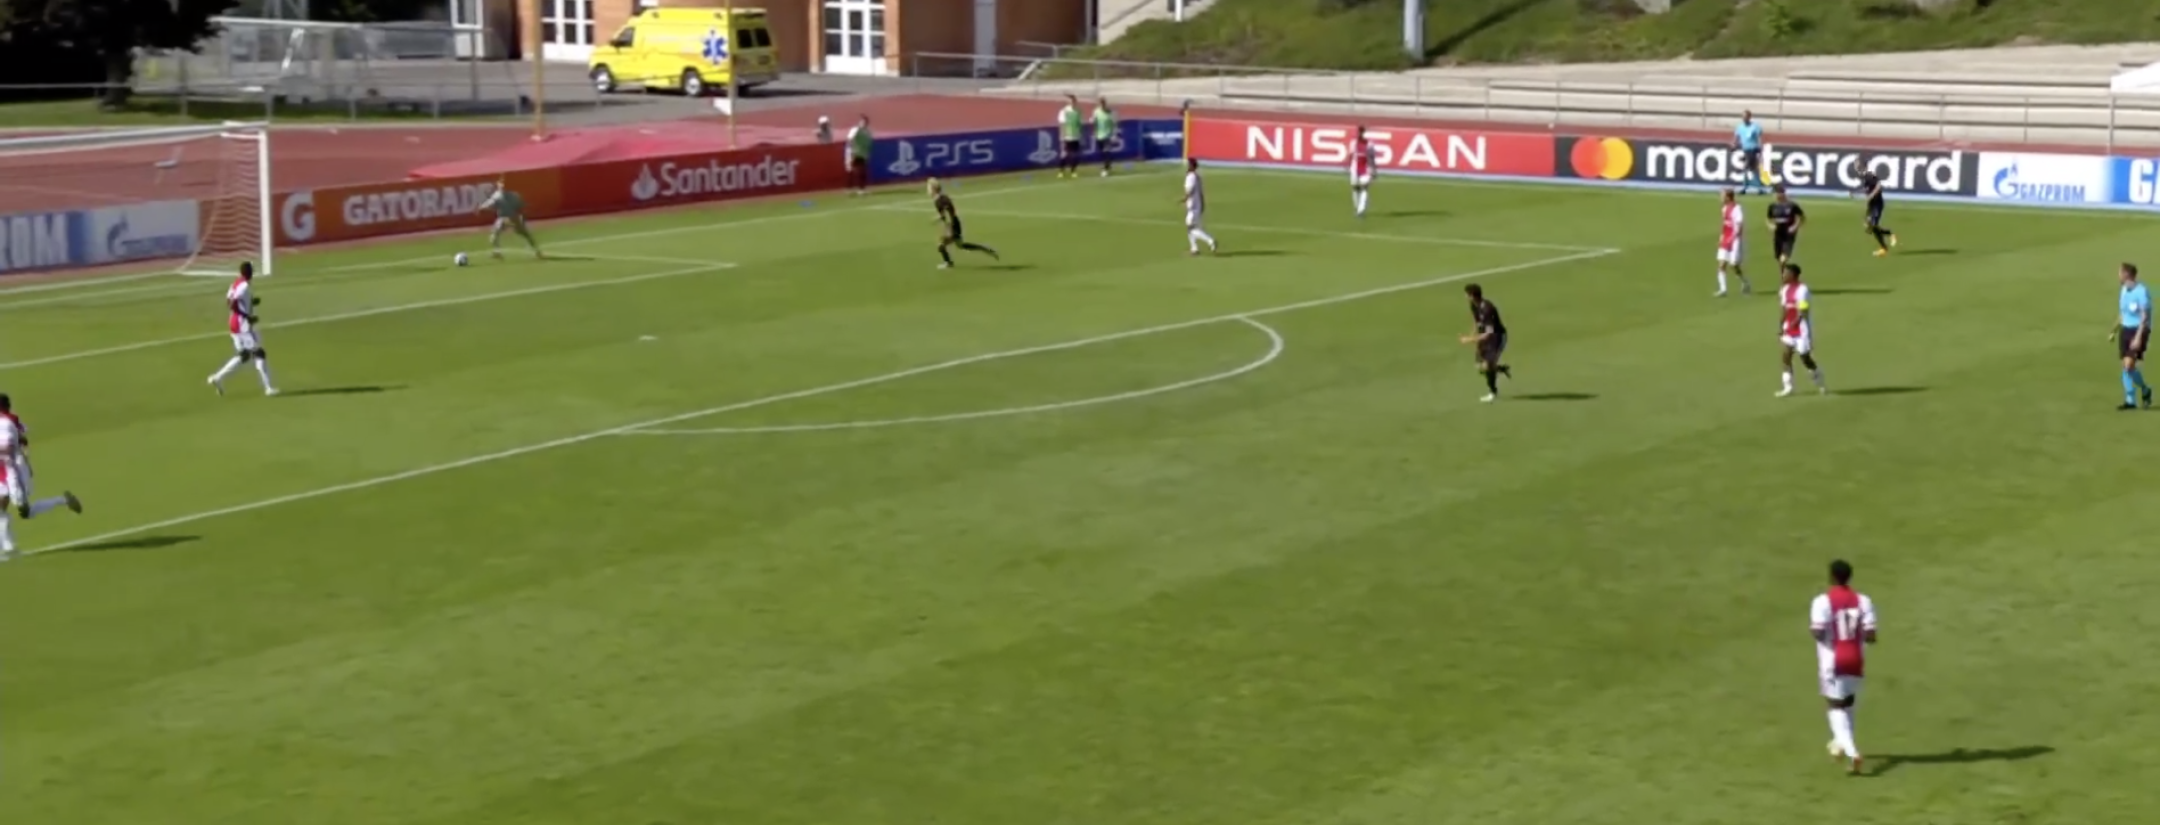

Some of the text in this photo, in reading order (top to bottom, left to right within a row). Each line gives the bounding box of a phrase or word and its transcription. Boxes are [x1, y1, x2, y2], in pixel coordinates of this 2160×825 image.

[925, 138, 994, 168] PS5
[1246, 124, 1487, 171] NISSAN
[1646, 142, 1962, 192] mastercard
[659, 154, 799, 196] Santander
[2019, 183, 2086, 203] GAZPROM
[282, 190, 315, 240] G
[1836, 607, 1860, 641] 17
